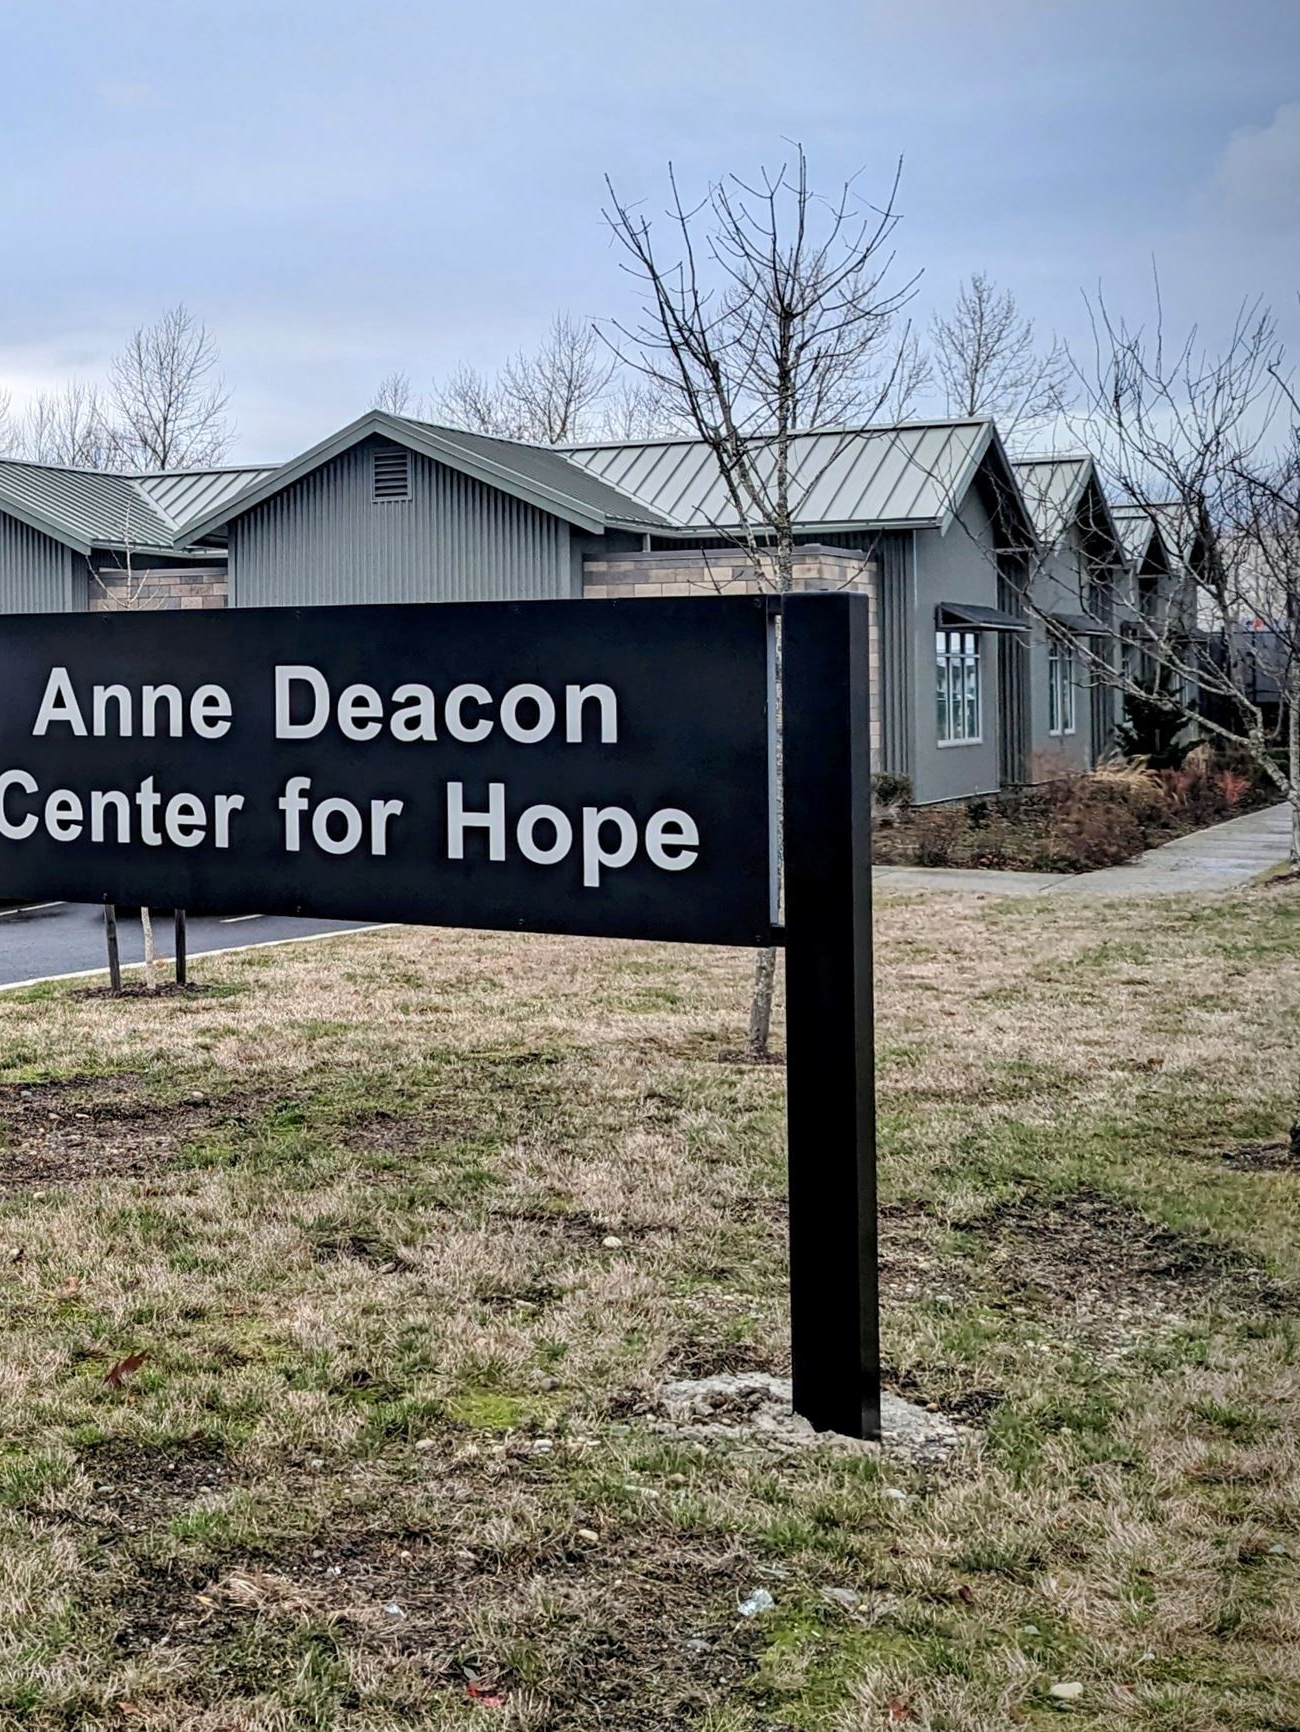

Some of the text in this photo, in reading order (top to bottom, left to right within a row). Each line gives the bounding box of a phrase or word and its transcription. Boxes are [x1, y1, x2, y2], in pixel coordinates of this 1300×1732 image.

[33, 666, 617, 743] Anne Deacon
[279, 777, 403, 855] for
[447, 782, 699, 887] Hope
